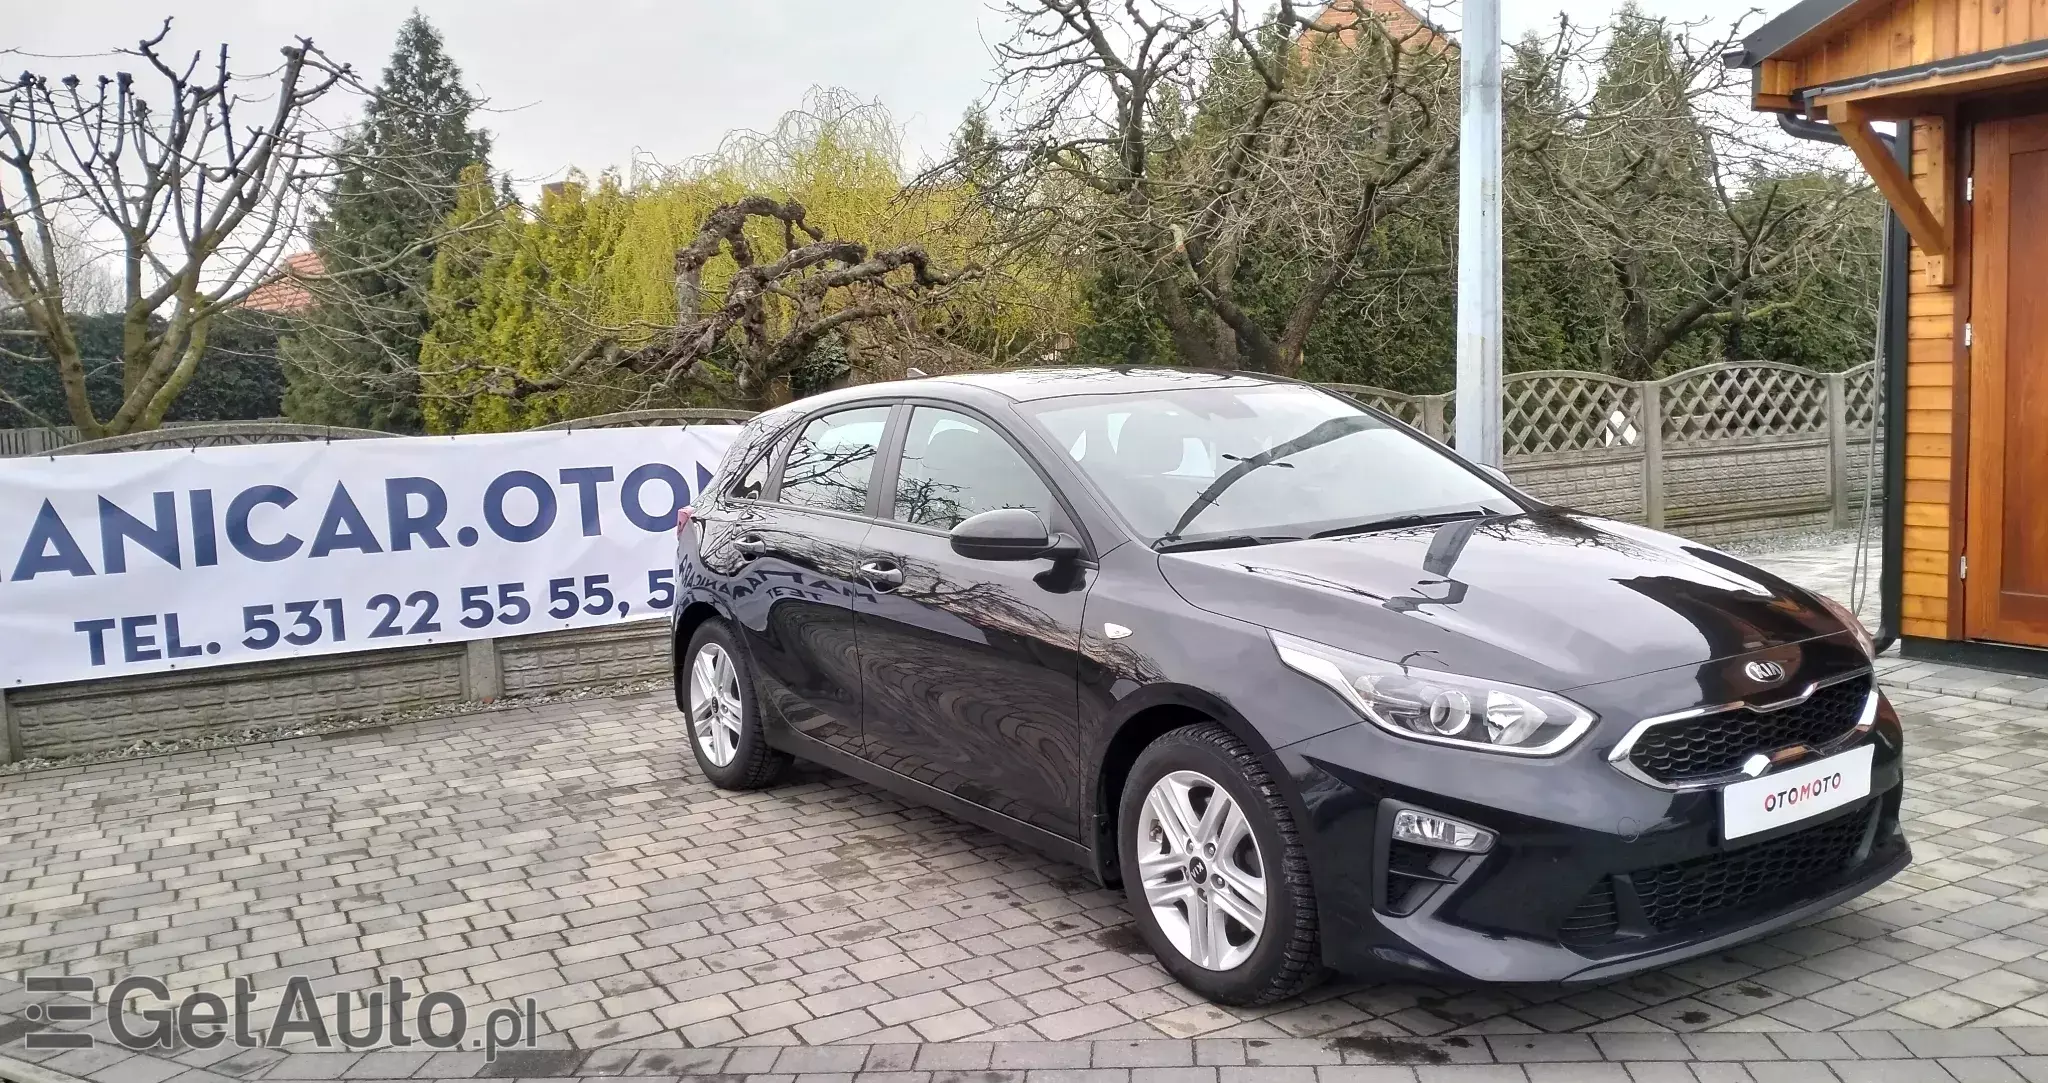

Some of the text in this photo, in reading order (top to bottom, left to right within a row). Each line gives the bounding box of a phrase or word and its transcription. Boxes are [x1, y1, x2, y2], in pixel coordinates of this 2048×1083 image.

[0, 460, 714, 583] ANICAR.OTO
[73, 616, 221, 667] TEL.
[241, 597, 346, 651] 531
[365, 590, 442, 640] 22
[459, 582, 531, 630] 55
[547, 573, 630, 619] 55,
[1750, 662, 1782, 679] KIA
[1763, 772, 1842, 813] OTOMOTO
[1190, 861, 1205, 878] KIA
